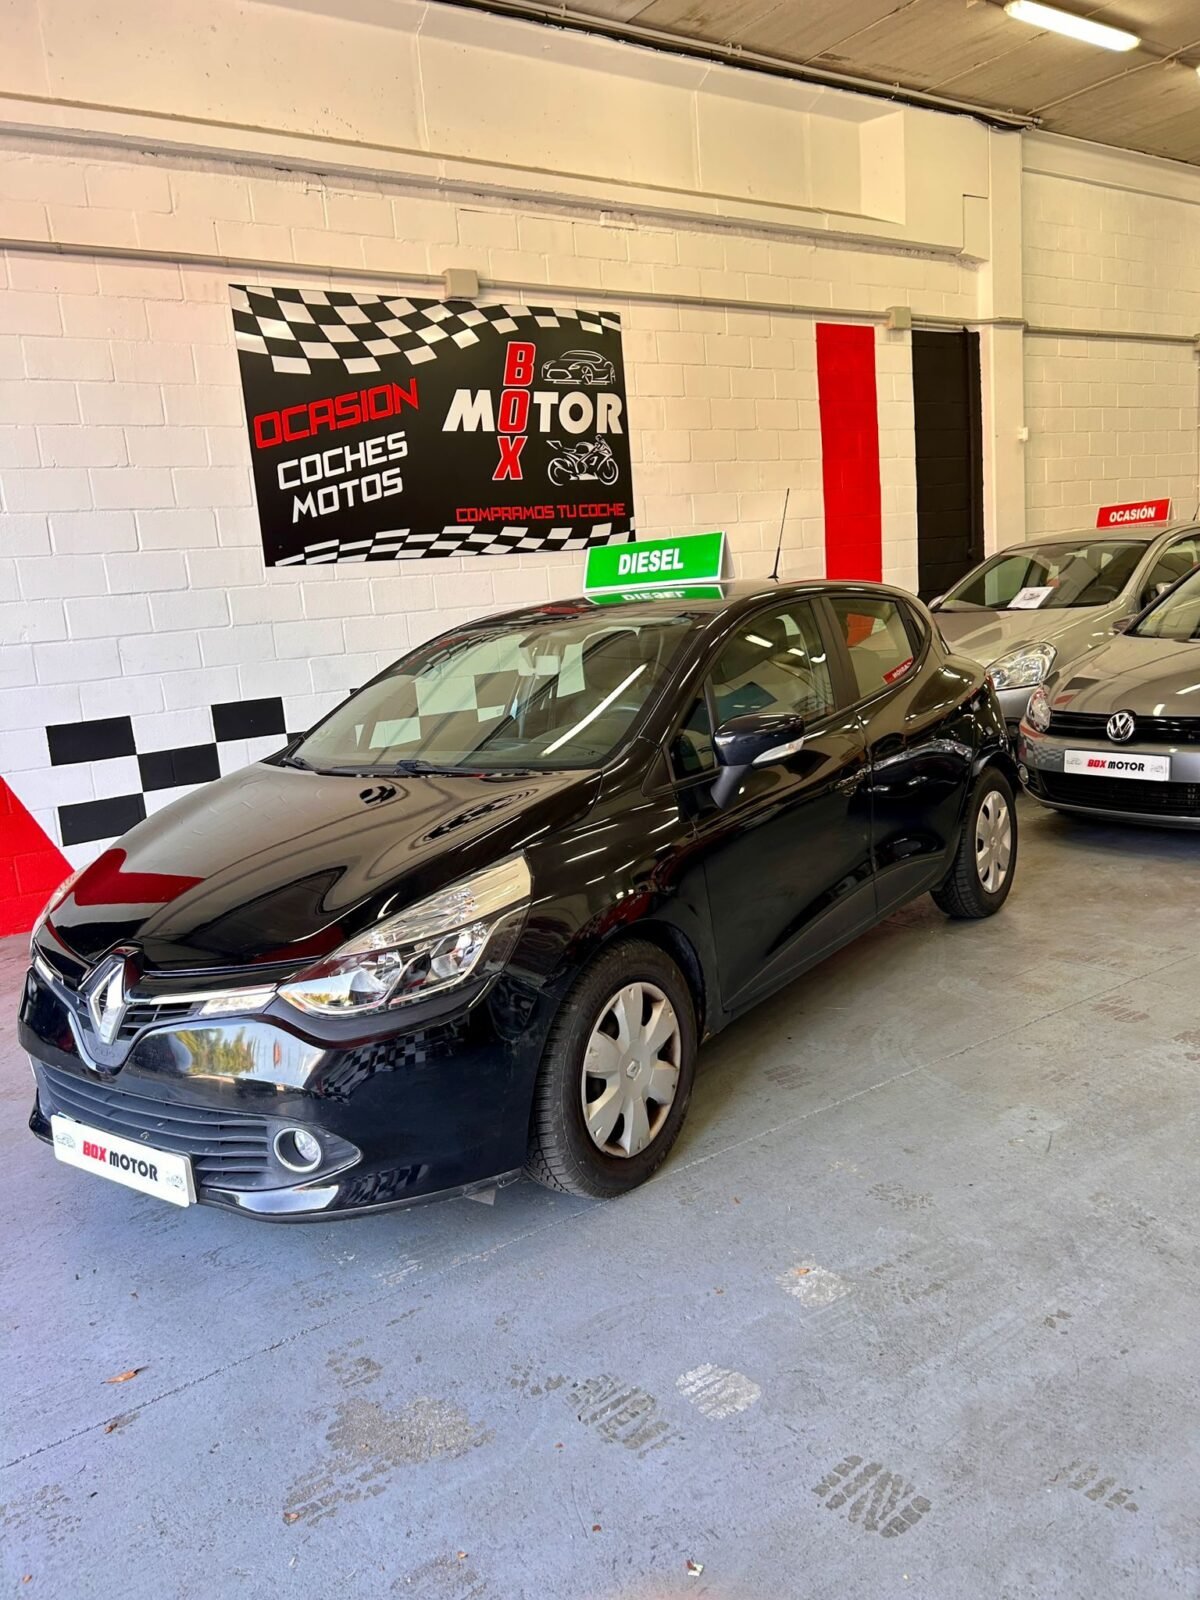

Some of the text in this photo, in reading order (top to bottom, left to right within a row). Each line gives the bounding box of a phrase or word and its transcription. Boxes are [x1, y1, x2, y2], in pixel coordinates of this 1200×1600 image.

[253, 378, 419, 449] OCASION
[442, 388, 623, 434] MOTOR
[492, 341, 536, 481] BOX
[277, 431, 408, 491] COCHES
[292, 467, 403, 524] MOTOS
[456, 503, 626, 522] COMPRAMOS TU COCHE
[1109, 505, 1156, 523] OCASIÓN
[618, 548, 684, 576] DIESEL
[1087, 759, 1145, 772] BOX MOTOR
[83, 1141, 158, 1181] BOX MOTOR
